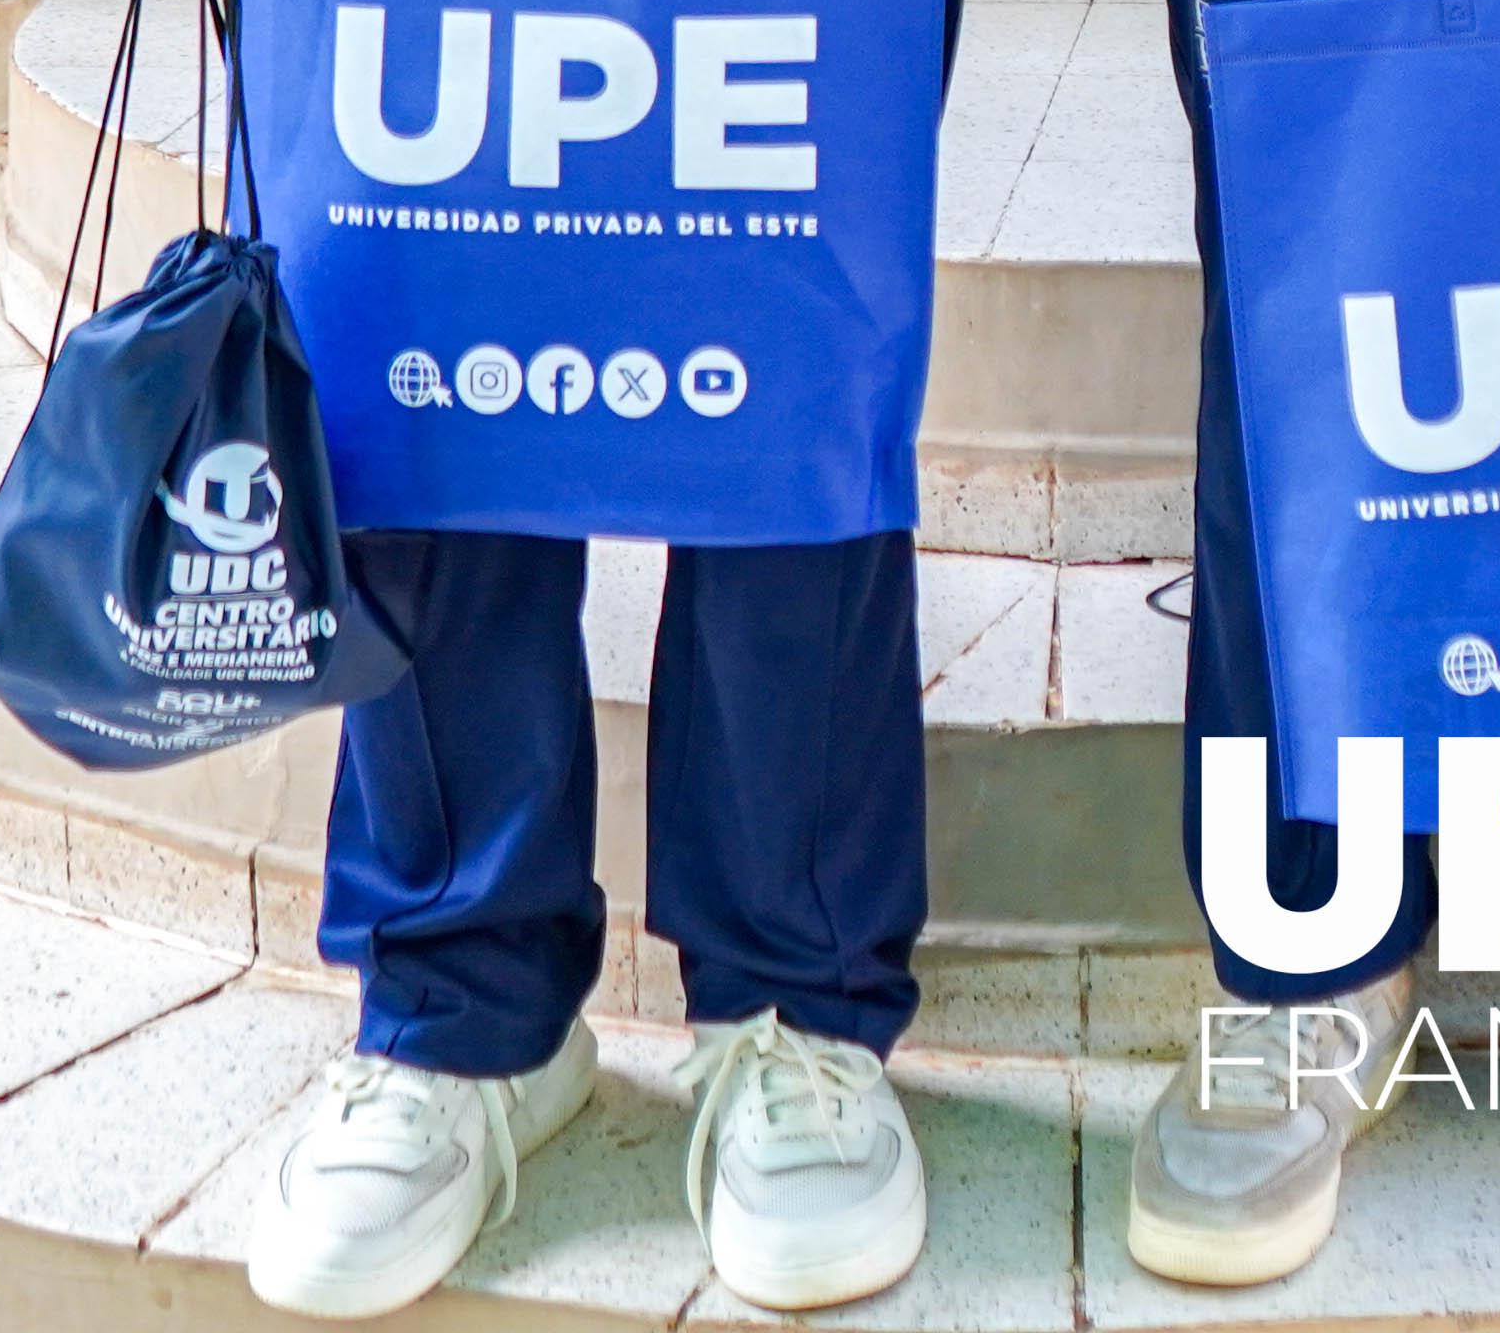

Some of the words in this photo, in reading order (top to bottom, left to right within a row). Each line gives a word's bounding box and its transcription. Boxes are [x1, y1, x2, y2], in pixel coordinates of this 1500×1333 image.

[333, 4, 817, 190] UPE
[328, 205, 520, 233] UNIVERSIDAD
[534, 214, 663, 235] PRIVADA
[677, 214, 732, 236] DEL
[748, 214, 818, 236] ESTE
[170, 548, 287, 595] UDC
[155, 596, 295, 628] CENTRO
[183, 647, 308, 669] MEDIANEIRA
